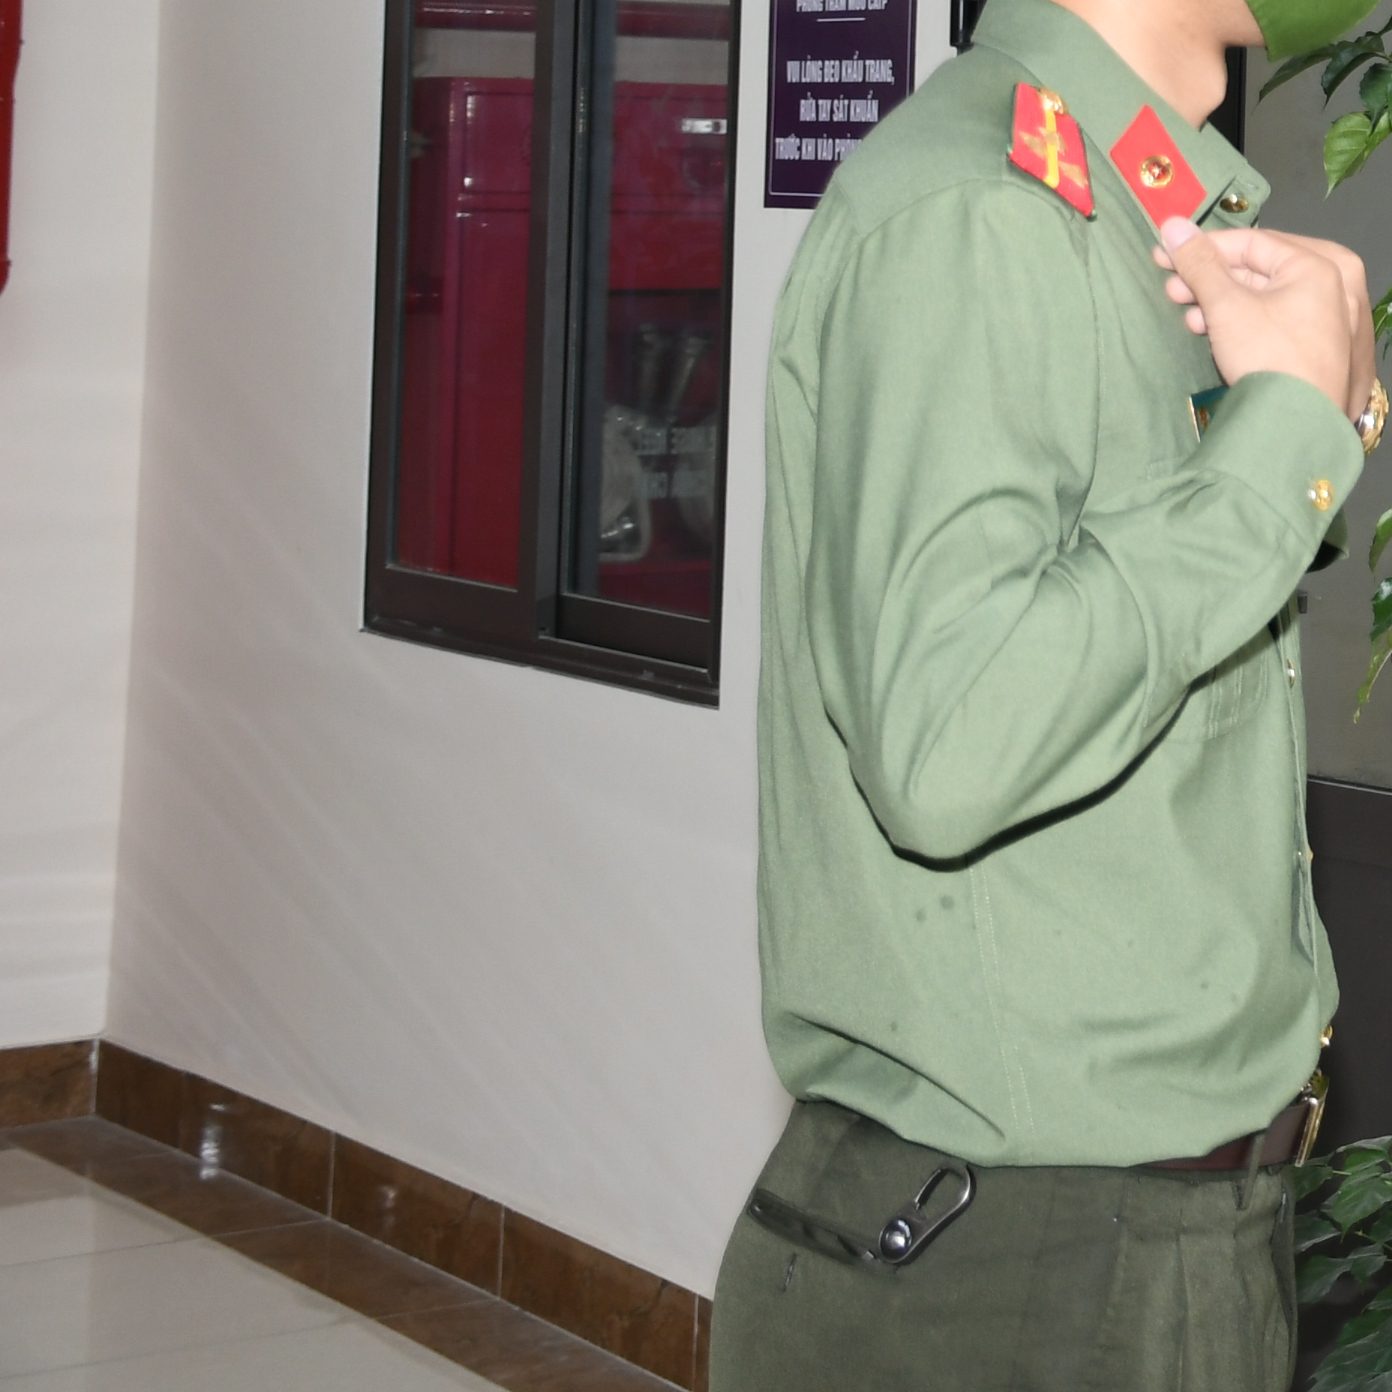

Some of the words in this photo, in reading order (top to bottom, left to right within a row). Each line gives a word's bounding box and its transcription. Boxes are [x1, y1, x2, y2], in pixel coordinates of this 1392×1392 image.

[787, 60, 800, 83] VUI
[818, 99, 832, 122] TAY
[801, 137, 816, 161] KHI
